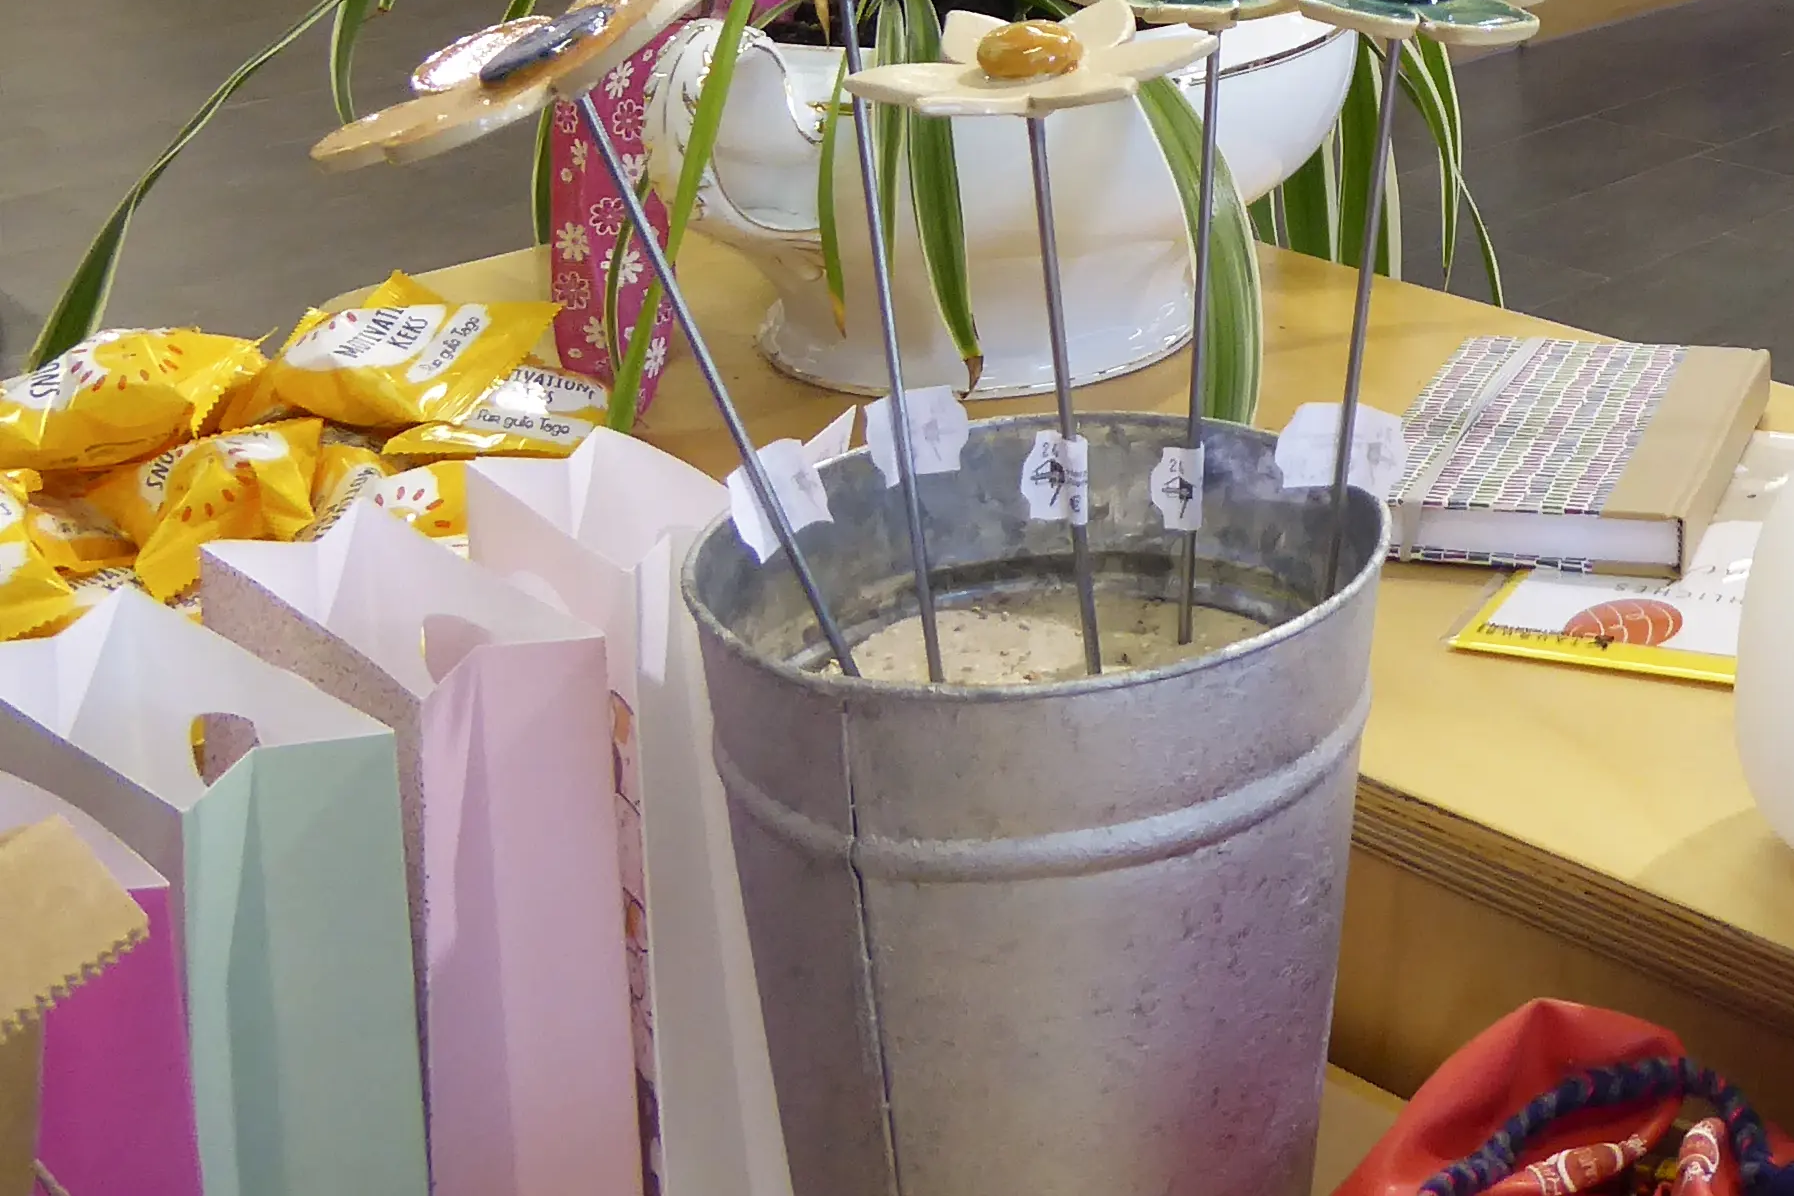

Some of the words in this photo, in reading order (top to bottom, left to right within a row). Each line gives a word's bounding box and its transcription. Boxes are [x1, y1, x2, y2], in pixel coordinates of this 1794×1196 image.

[333, 306, 404, 358] MOTIVATI
[387, 316, 429, 350] KEKS
[29, 362, 61, 399] ONS
[146, 451, 176, 491] ONS
